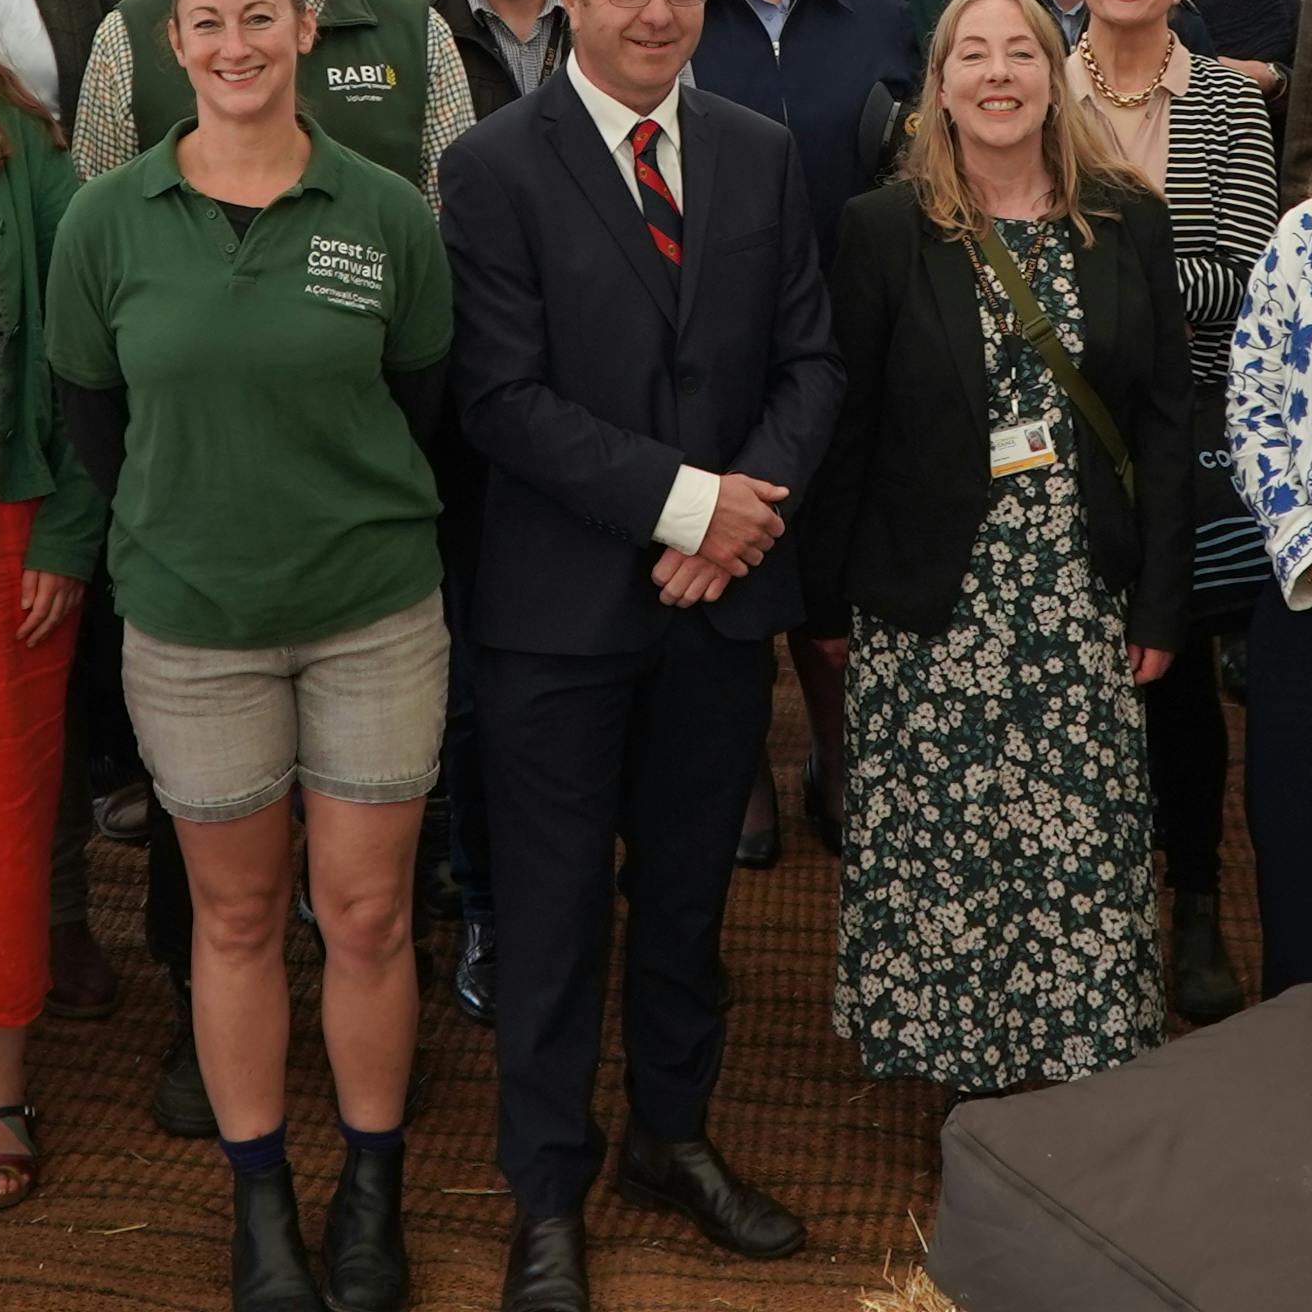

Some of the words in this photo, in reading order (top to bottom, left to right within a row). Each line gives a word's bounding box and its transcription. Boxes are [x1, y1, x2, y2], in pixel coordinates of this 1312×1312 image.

[327, 65, 383, 85] RABI
[310, 235, 364, 259] Forest
[366, 246, 387, 263] for
[307, 251, 383, 281] Cornwall
[307, 266, 333, 277] Koos
